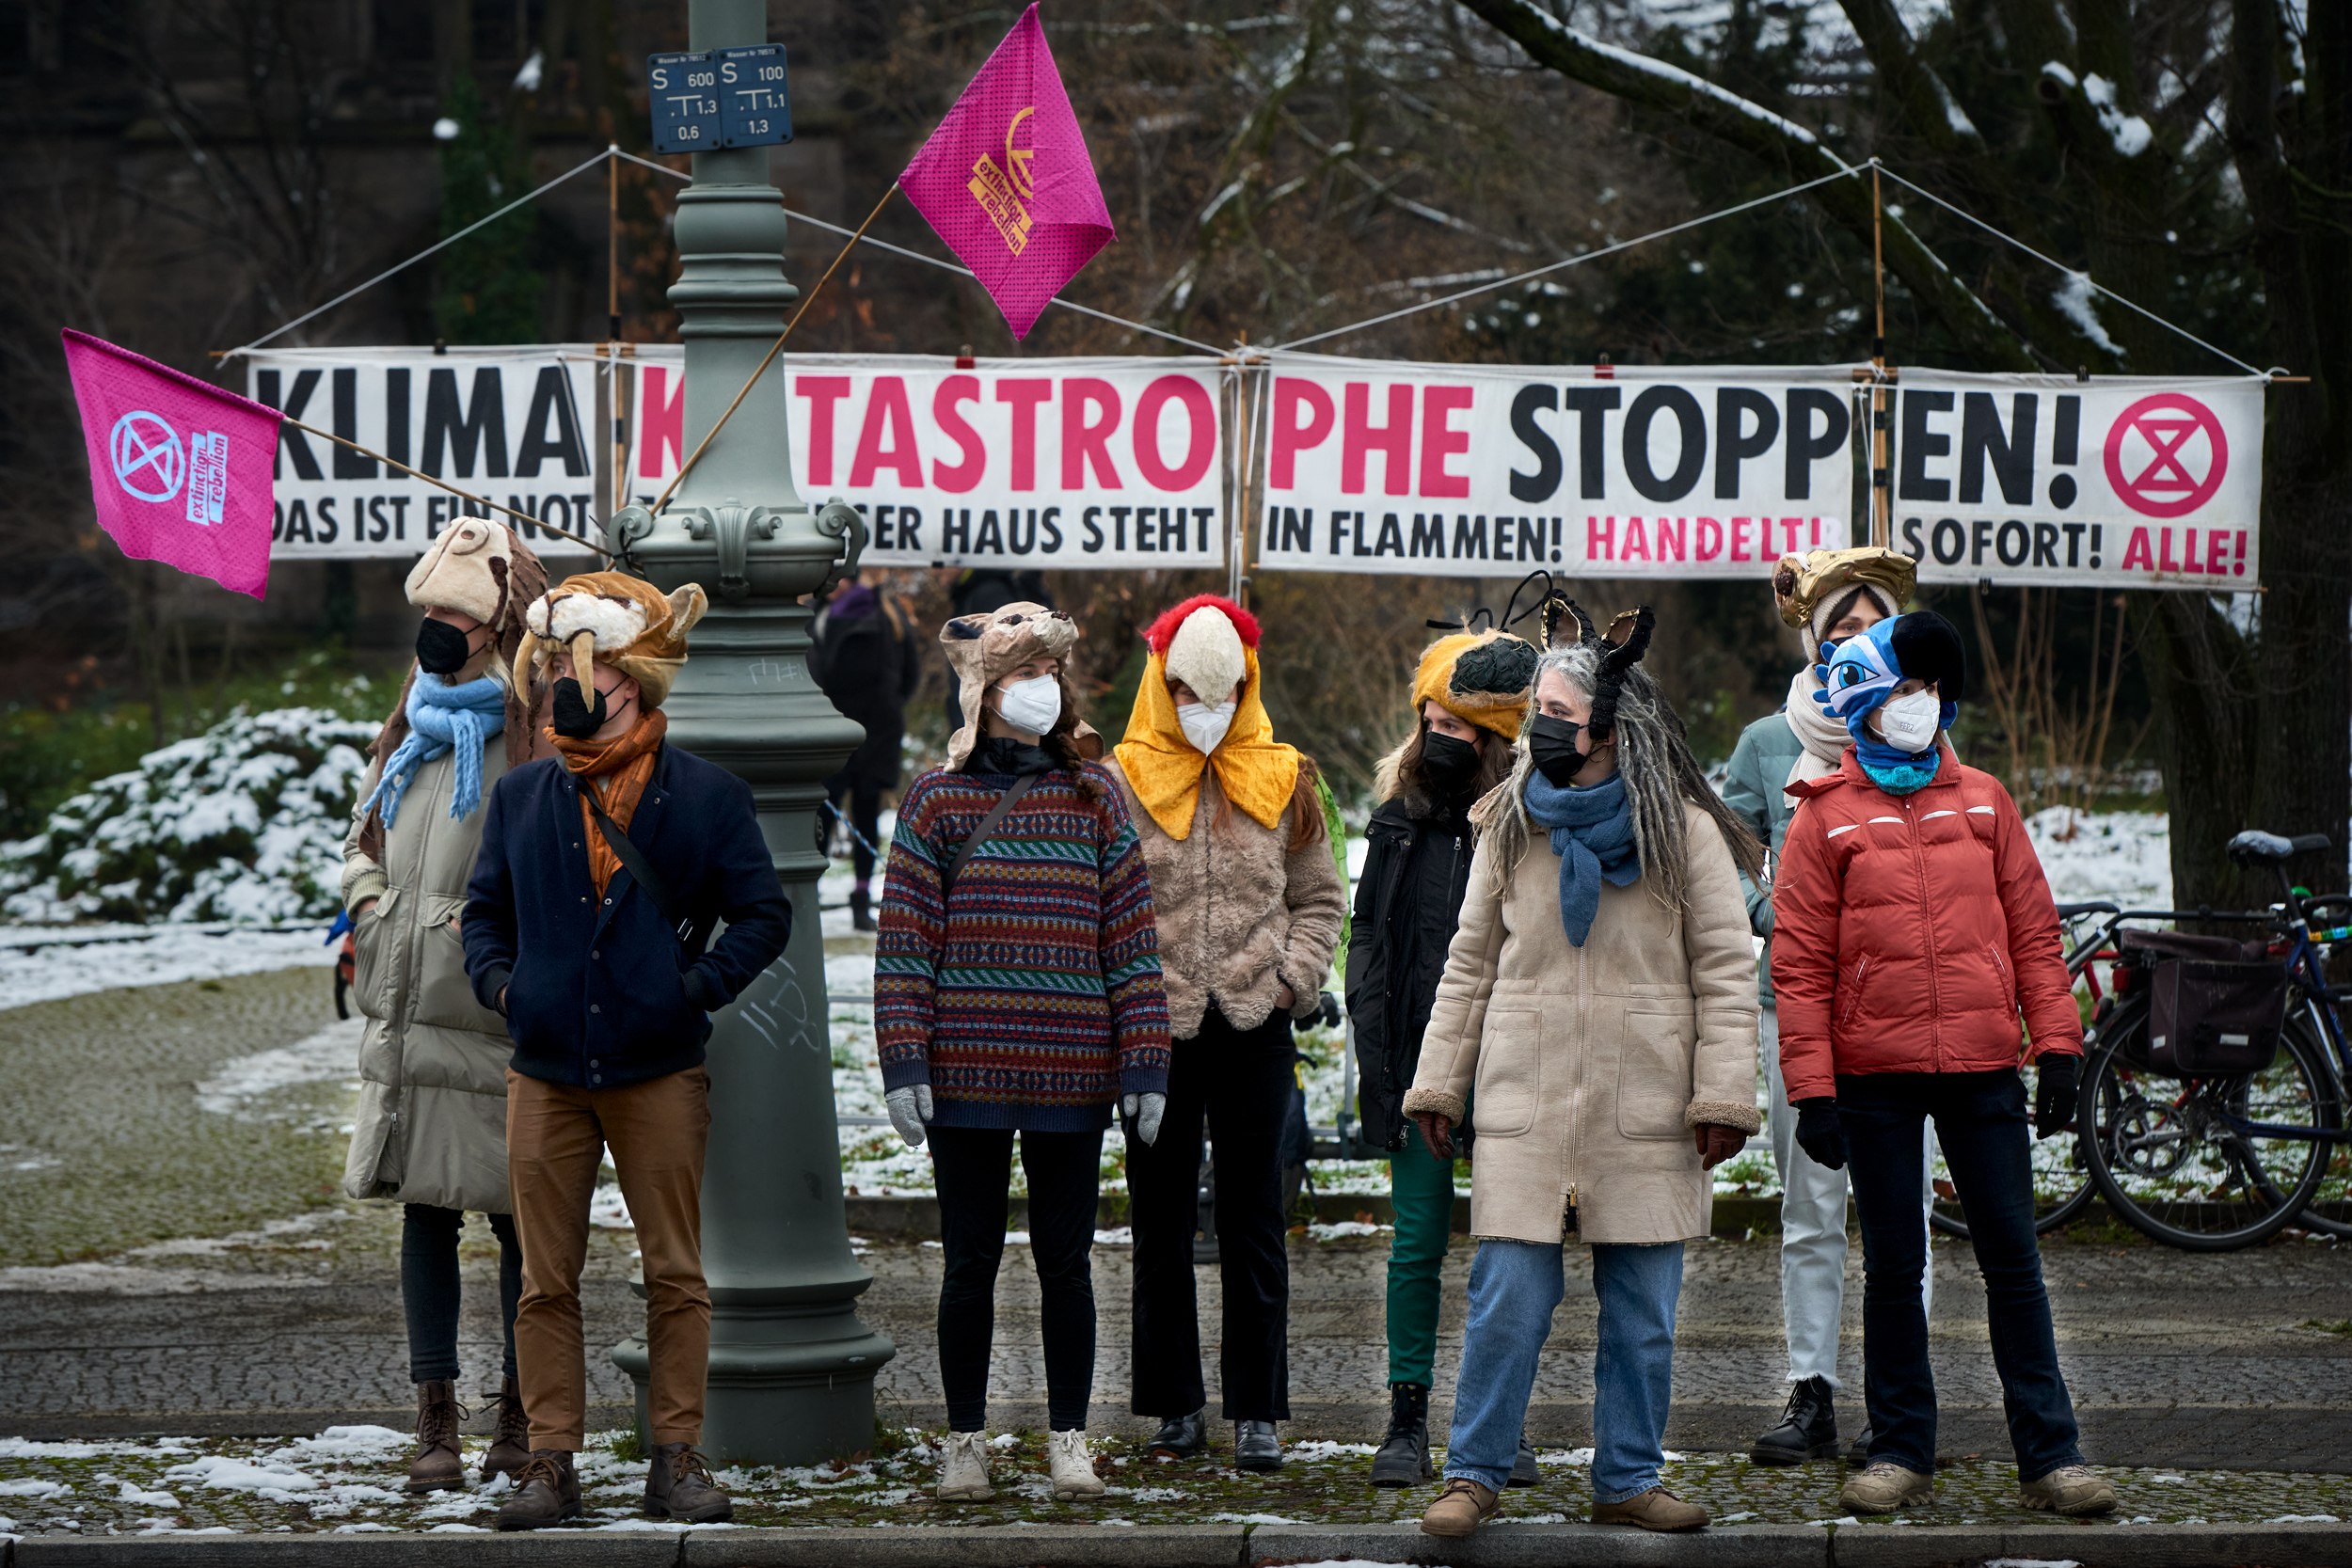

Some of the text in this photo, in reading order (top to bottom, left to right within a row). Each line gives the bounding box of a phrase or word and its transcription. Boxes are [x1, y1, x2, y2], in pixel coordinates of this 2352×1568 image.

[652, 69, 715, 89] S 600
[722, 62, 784, 83] S 100
[979, 161, 1023, 225] extinction
[980, 191, 1022, 252] rebellion
[207, 437, 225, 503] rebellion
[257, 367, 590, 480] KLIMA
[1270, 376, 1473, 498] PHE
[1899, 389, 2081, 510] EN!
[190, 447, 207, 518] extinction
[354, 496, 410, 542] IST
[509, 495, 591, 541] NOT
[943, 508, 1062, 555] HAUS
[1082, 506, 1215, 553] STEHT
[1267, 506, 1312, 552] IN
[1330, 511, 1563, 562] FLAMMEN!
[1902, 517, 2103, 569] SOFORT!
[2122, 526, 2247, 577] ALLE!
[1899, 721, 1915, 732] FFP2
